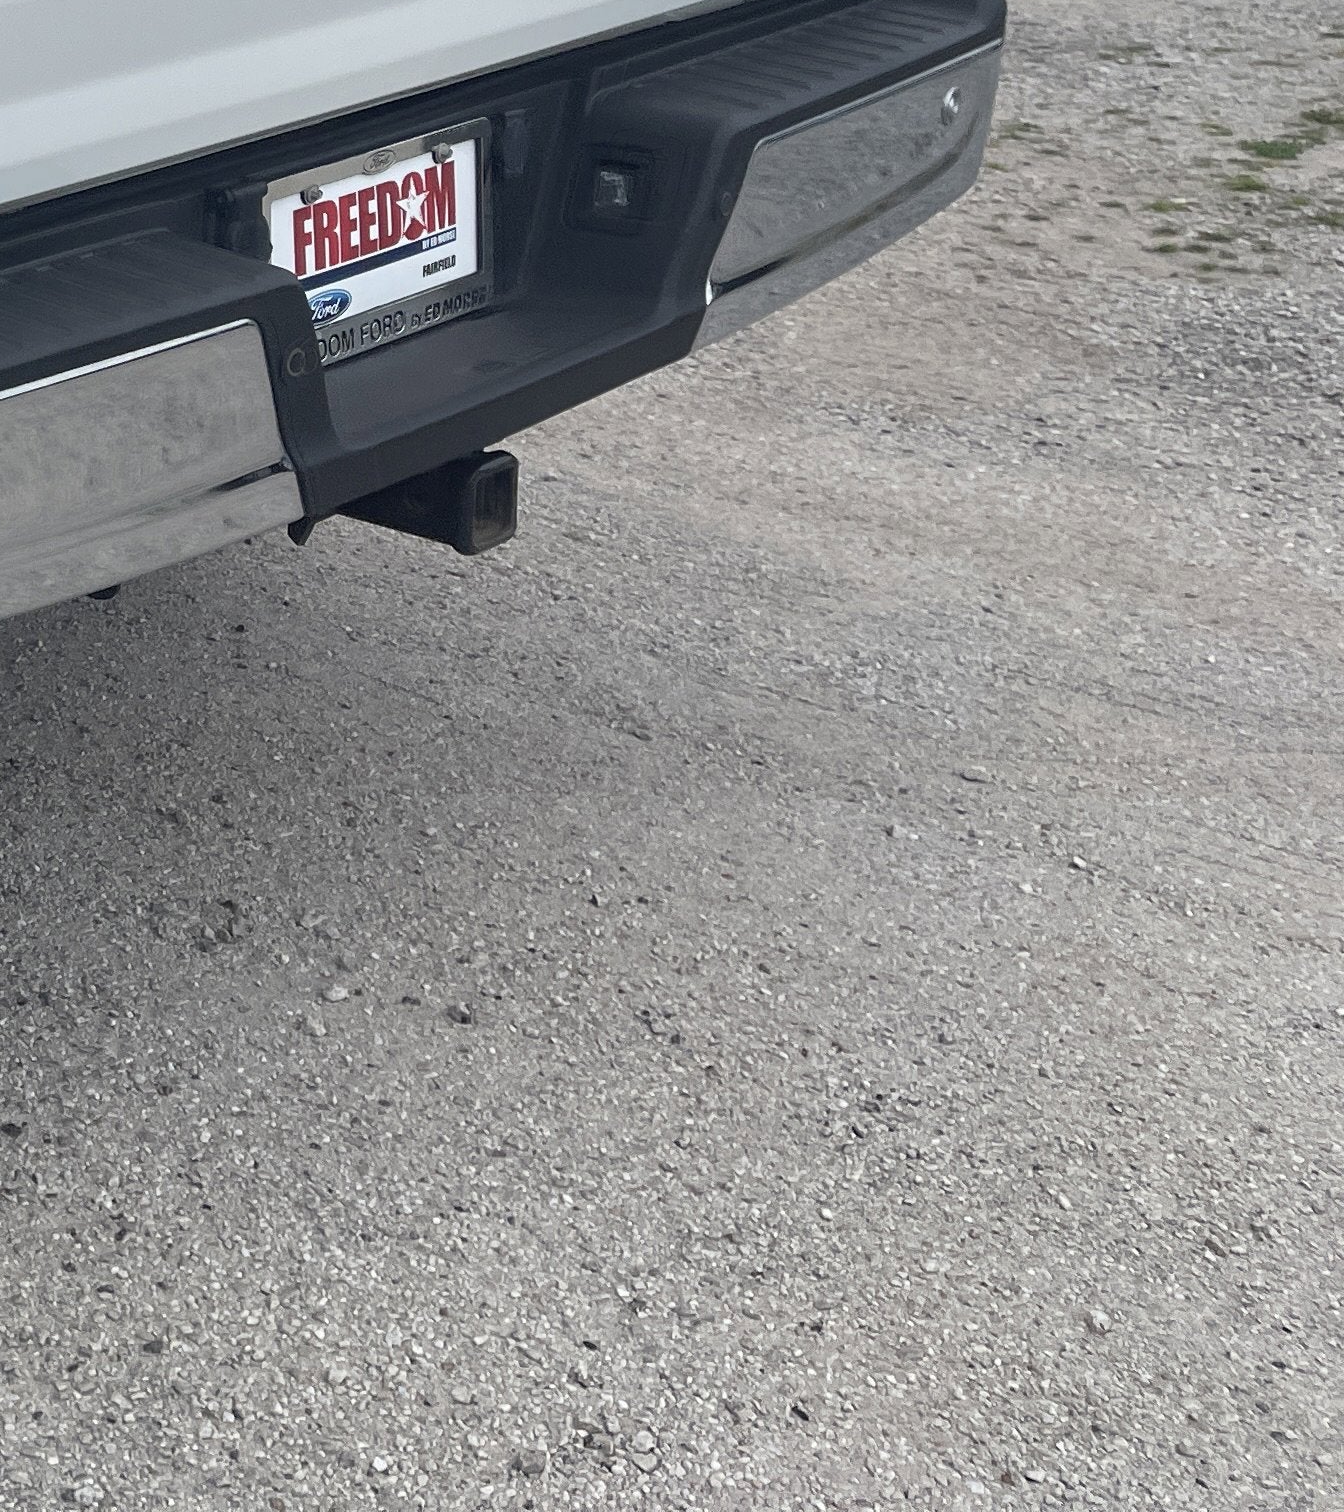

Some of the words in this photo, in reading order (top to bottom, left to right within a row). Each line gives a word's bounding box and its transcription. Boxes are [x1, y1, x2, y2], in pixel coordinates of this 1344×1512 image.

[292, 160, 457, 277] FREEDOM
[311, 295, 341, 321] Ford
[317, 327, 356, 363] DOM
[360, 310, 406, 346] FORD
